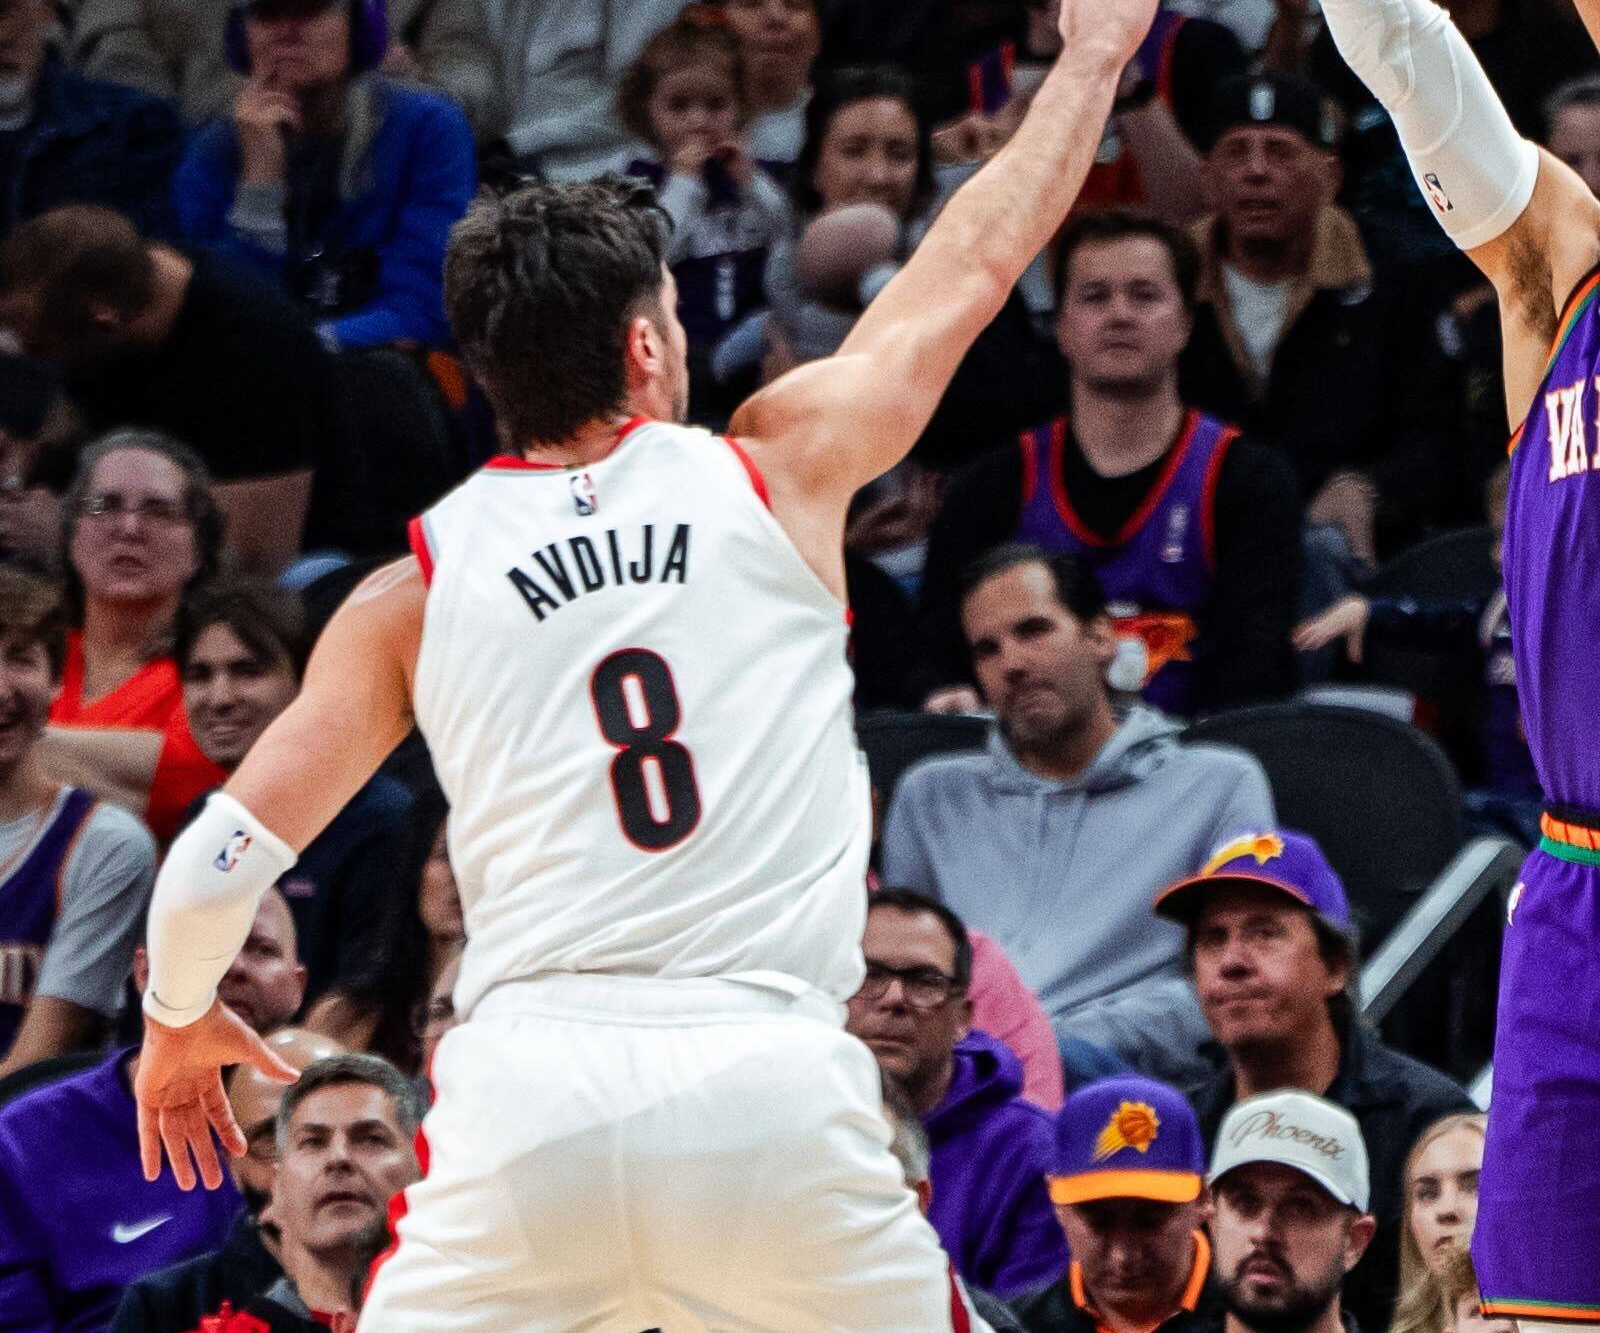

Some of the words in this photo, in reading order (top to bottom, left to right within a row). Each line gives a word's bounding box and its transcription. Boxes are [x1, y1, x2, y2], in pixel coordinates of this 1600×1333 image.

[506, 523, 692, 622] AVDIJA
[588, 647, 703, 855] 8
[1229, 1110, 1345, 1160] Phoenix
